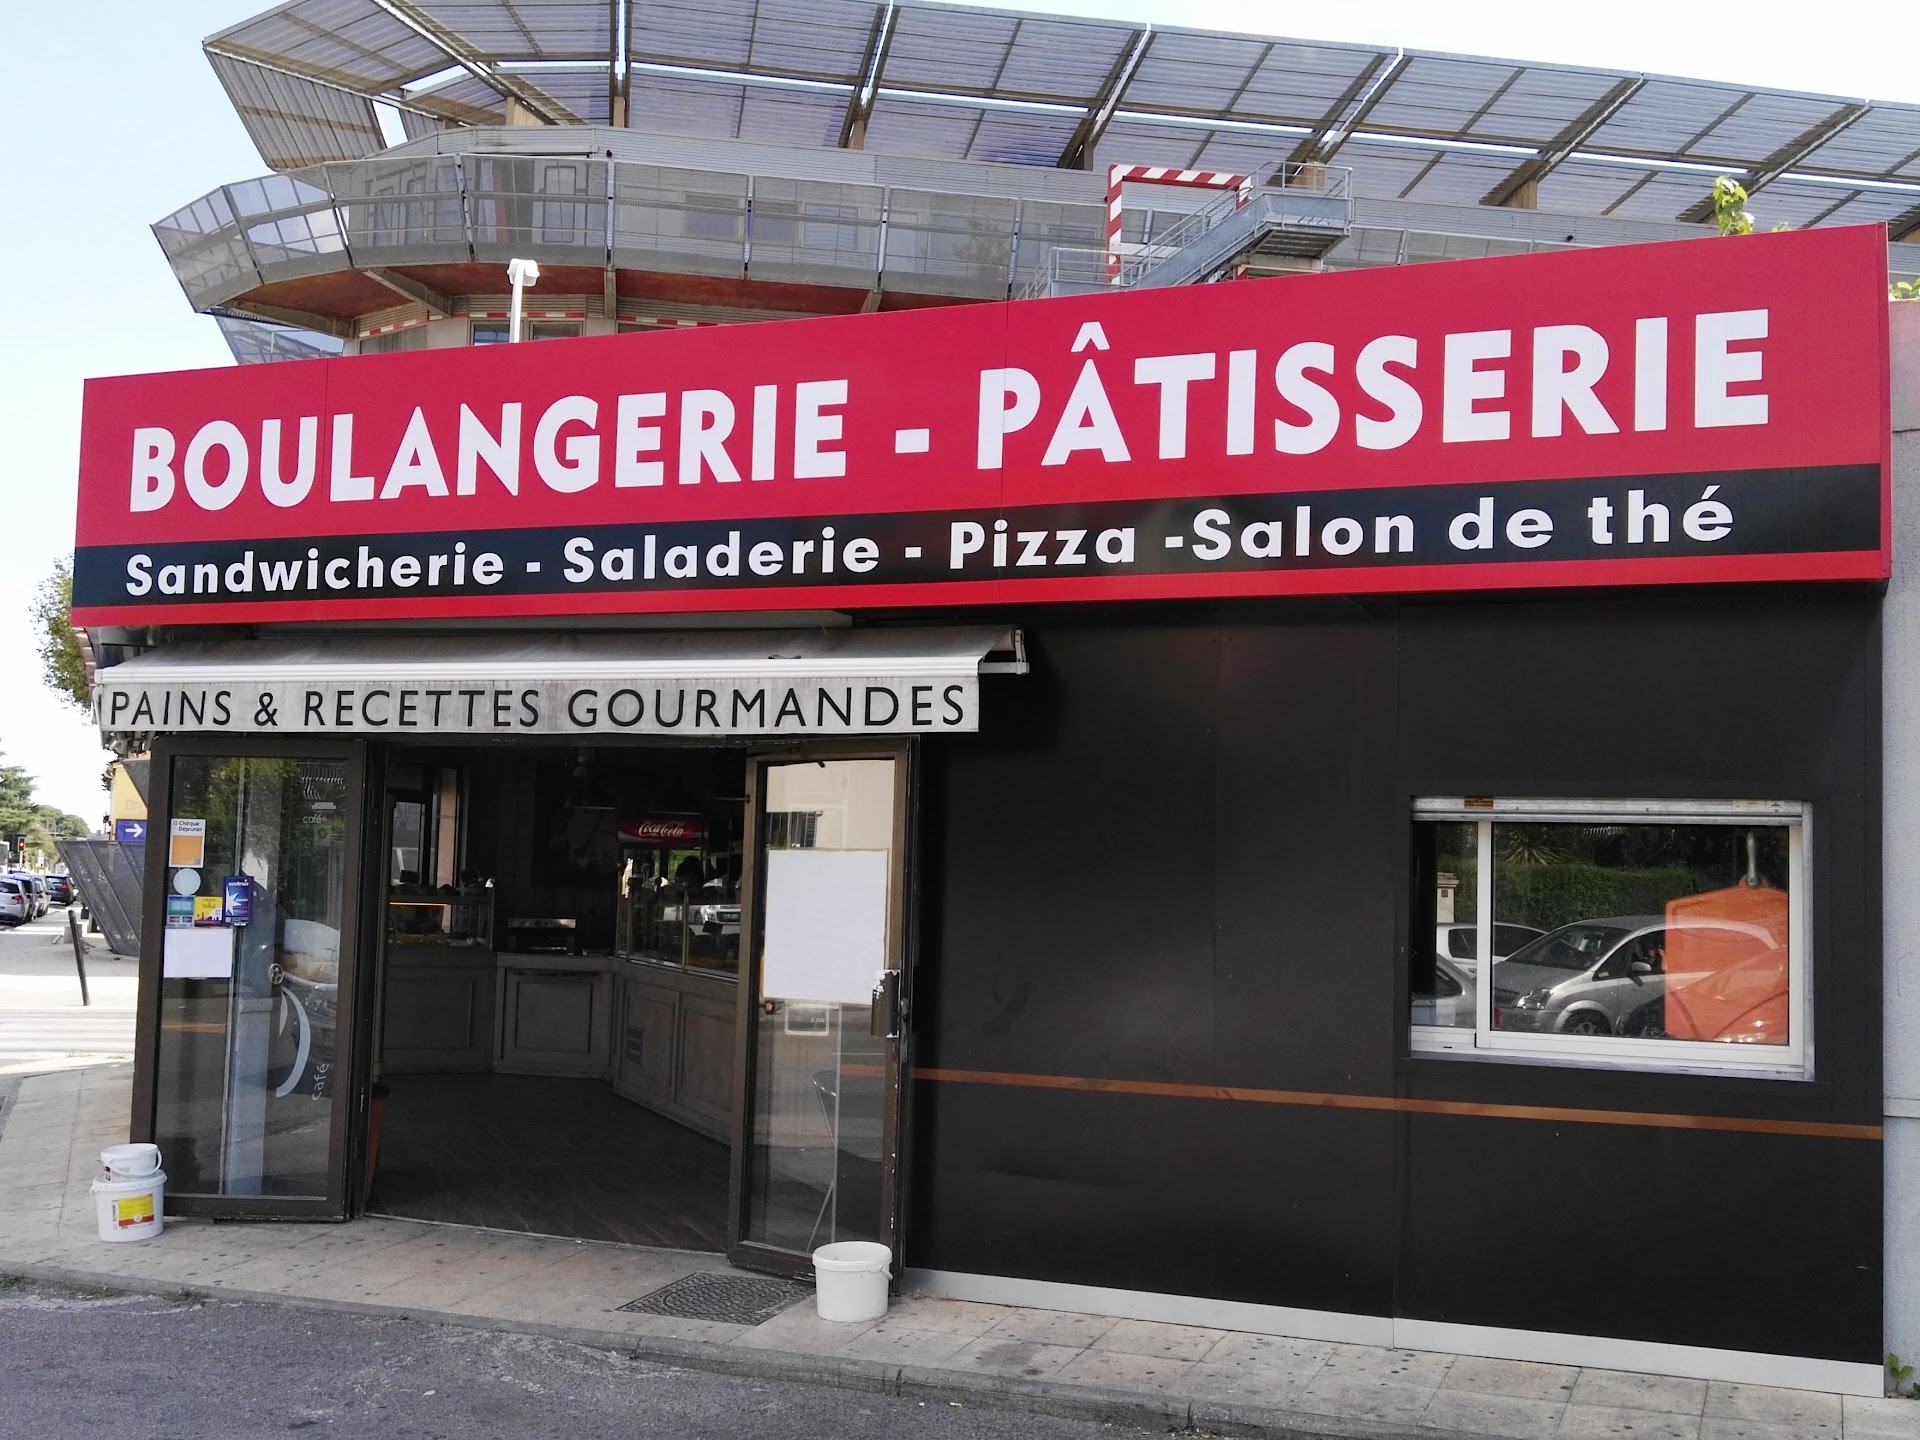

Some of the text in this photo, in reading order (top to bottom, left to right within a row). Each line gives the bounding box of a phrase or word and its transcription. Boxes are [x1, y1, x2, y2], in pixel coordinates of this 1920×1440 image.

[129, 309, 1770, 513] BOULANGERIE - PÂTISSERIE
[125, 541, 504, 596] Sandwicherie
[526, 561, 541, 573] -
[563, 526, 880, 584] Saladerie
[904, 546, 922, 559] -
[949, 518, 1135, 570] Pizza
[1448, 496, 1554, 550] de
[1587, 484, 1733, 545] thé
[110, 684, 964, 728] PAINS & RECETTES GOURMANDES
[311, 1063, 330, 1101] café
